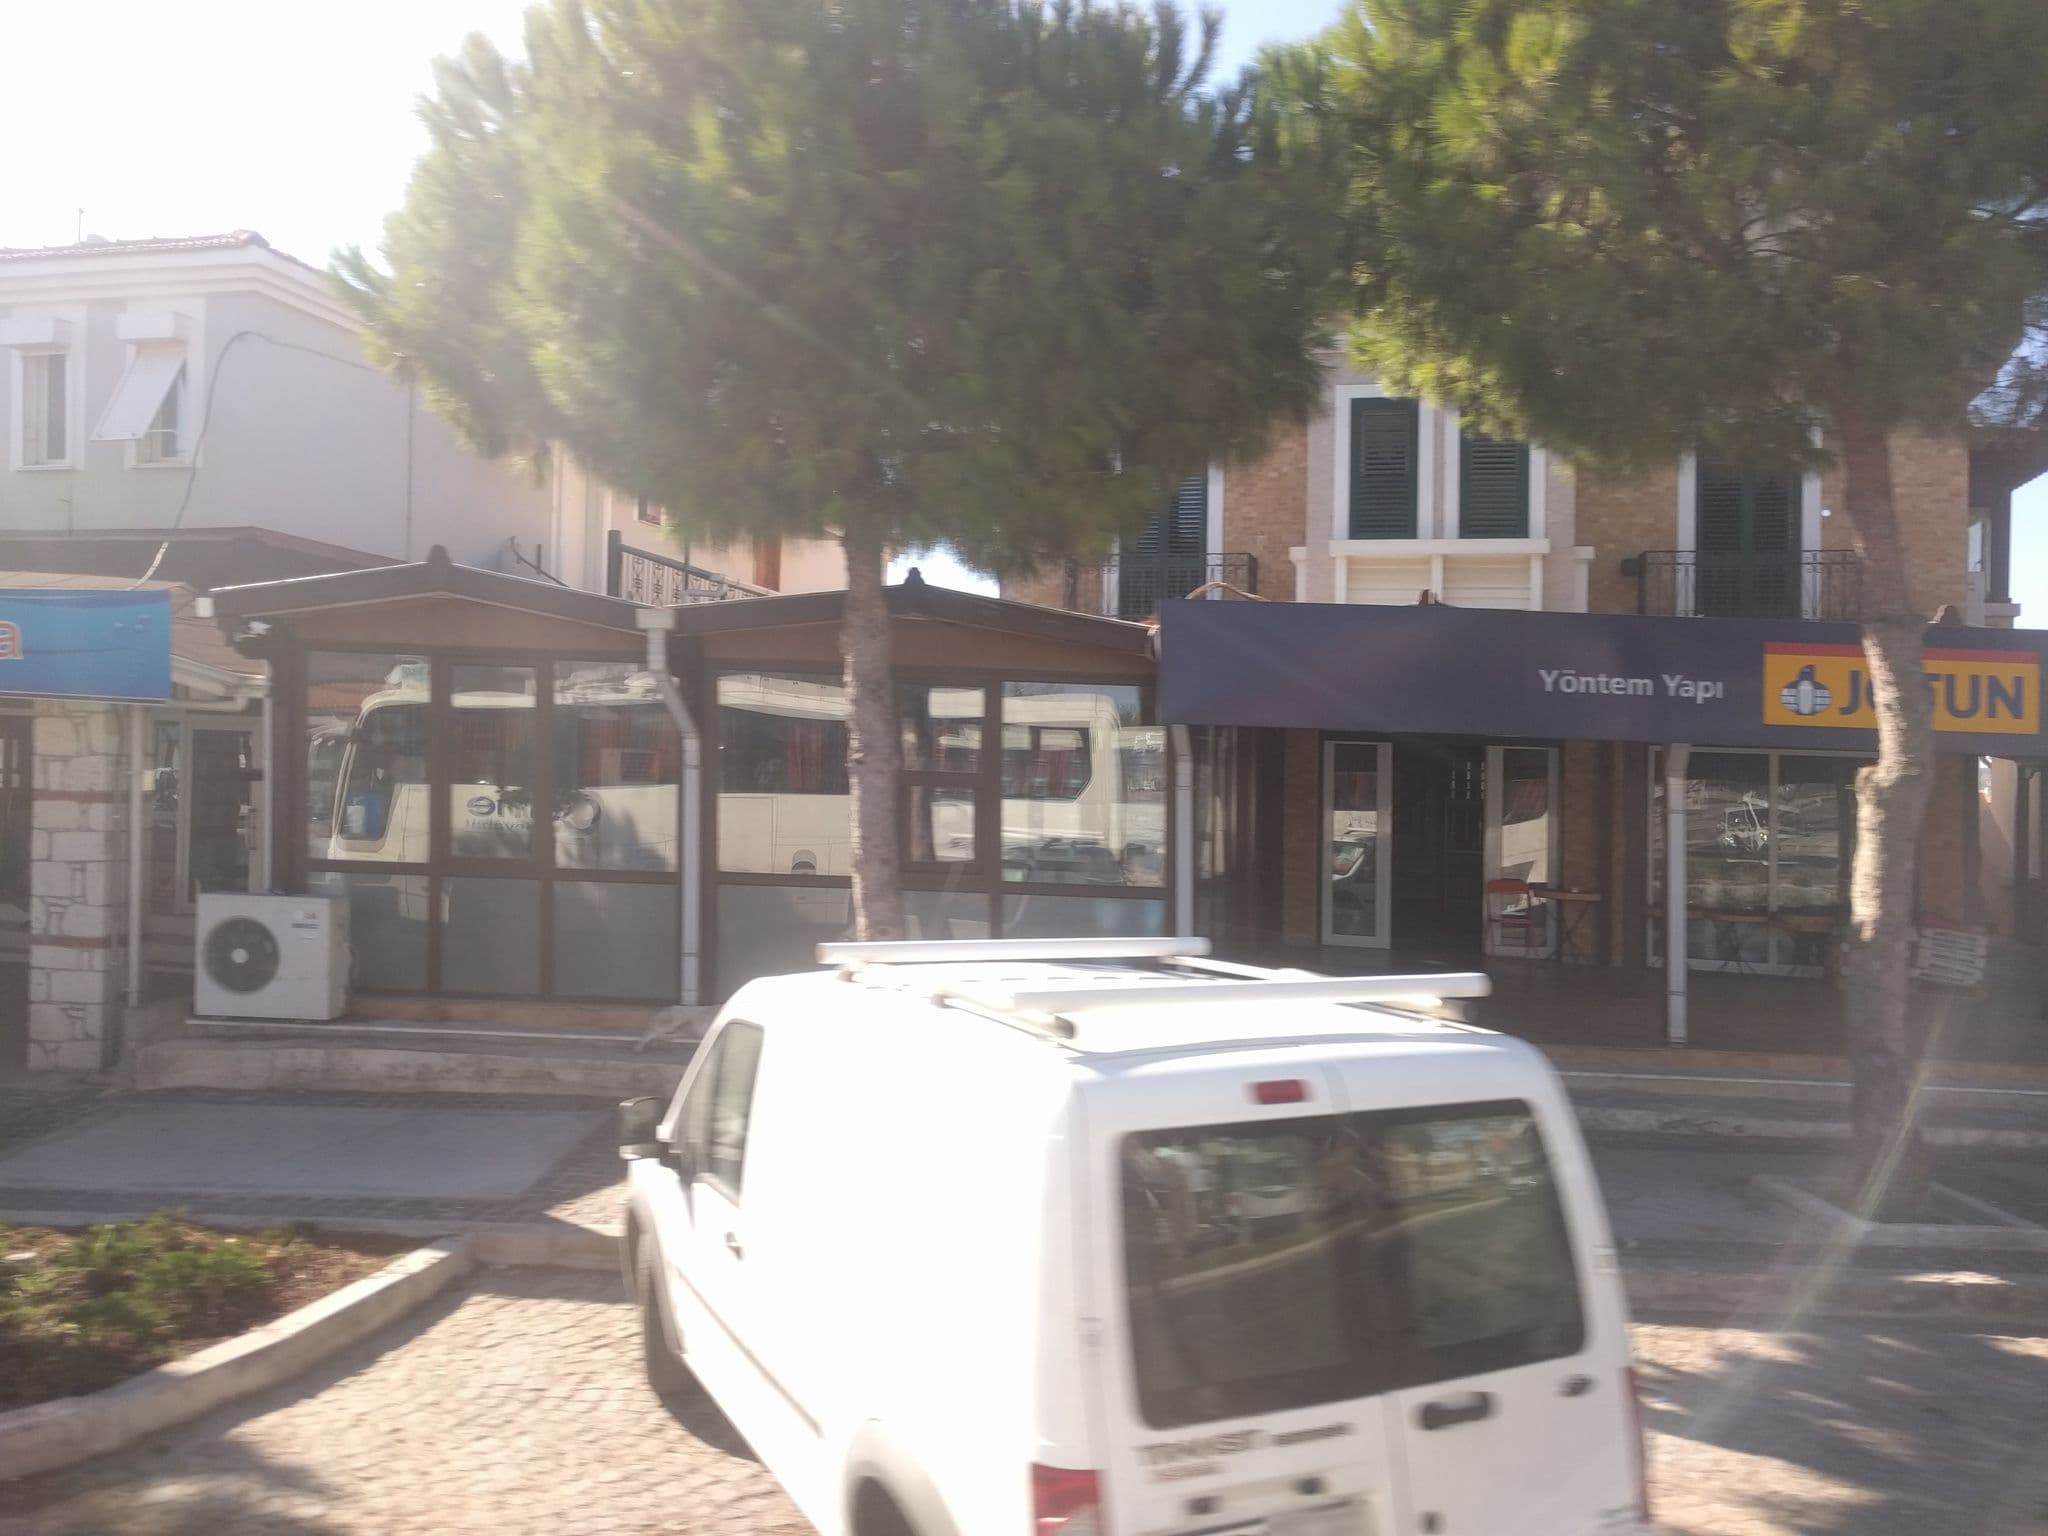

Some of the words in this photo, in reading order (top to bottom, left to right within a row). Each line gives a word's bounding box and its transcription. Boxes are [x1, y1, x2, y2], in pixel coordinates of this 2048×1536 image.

[1538, 668, 1654, 696] Yöntem
[1661, 674, 1724, 704] Yapı
[1839, 669, 2024, 720] JUN
